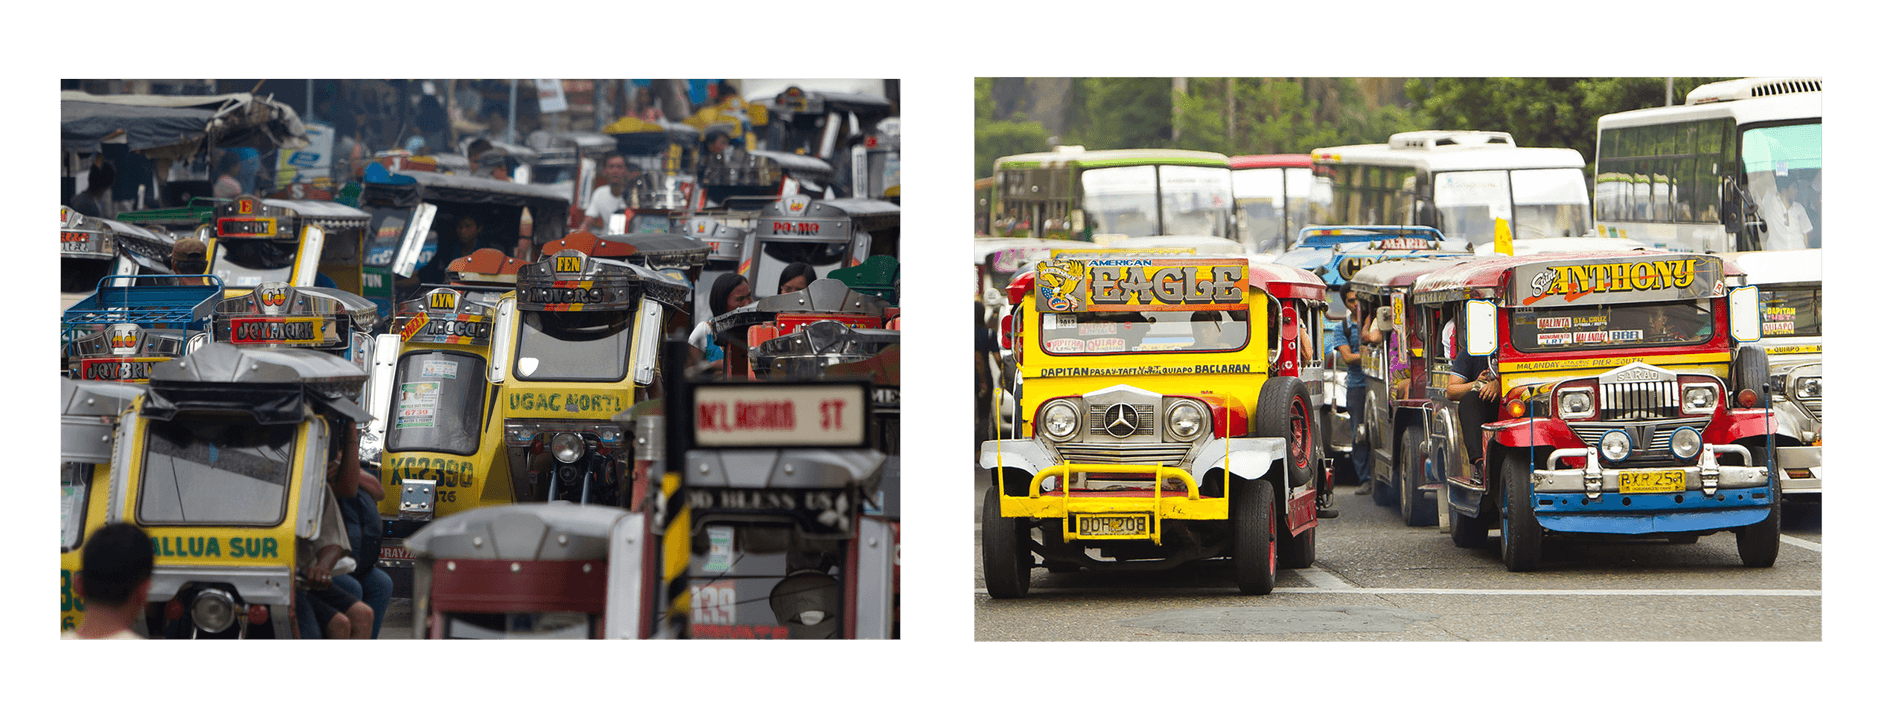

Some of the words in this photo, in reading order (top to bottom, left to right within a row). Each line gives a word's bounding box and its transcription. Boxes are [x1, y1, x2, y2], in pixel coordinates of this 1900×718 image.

[1382, 238, 1428, 249] MARIE
[556, 256, 581, 273] FEN
[1088, 259, 1152, 267] AMERICAN
[1531, 268, 1557, 297] Saint
[1546, 259, 1697, 295] ANTHONY
[1089, 266, 1243, 304] EAGLE
[431, 293, 455, 308] LYN
[1767, 307, 1796, 315] DAPITAN
[1539, 319, 1570, 328] MALINTA
[1764, 322, 1793, 332] QUIAPO
[112, 330, 138, 348] AJ
[1087, 339, 1124, 352] QUIAPO
[1517, 361, 1559, 370] MALANDAY
[1592, 358, 1612, 367] PIER
[1614, 357, 1644, 365] SOUTH
[1041, 367, 1088, 377] DAPITAN
[1195, 364, 1250, 374] BACLARAN
[510, 393, 561, 411] UGAC
[819, 399, 847, 431] ST
[229, 537, 278, 558] SUR
